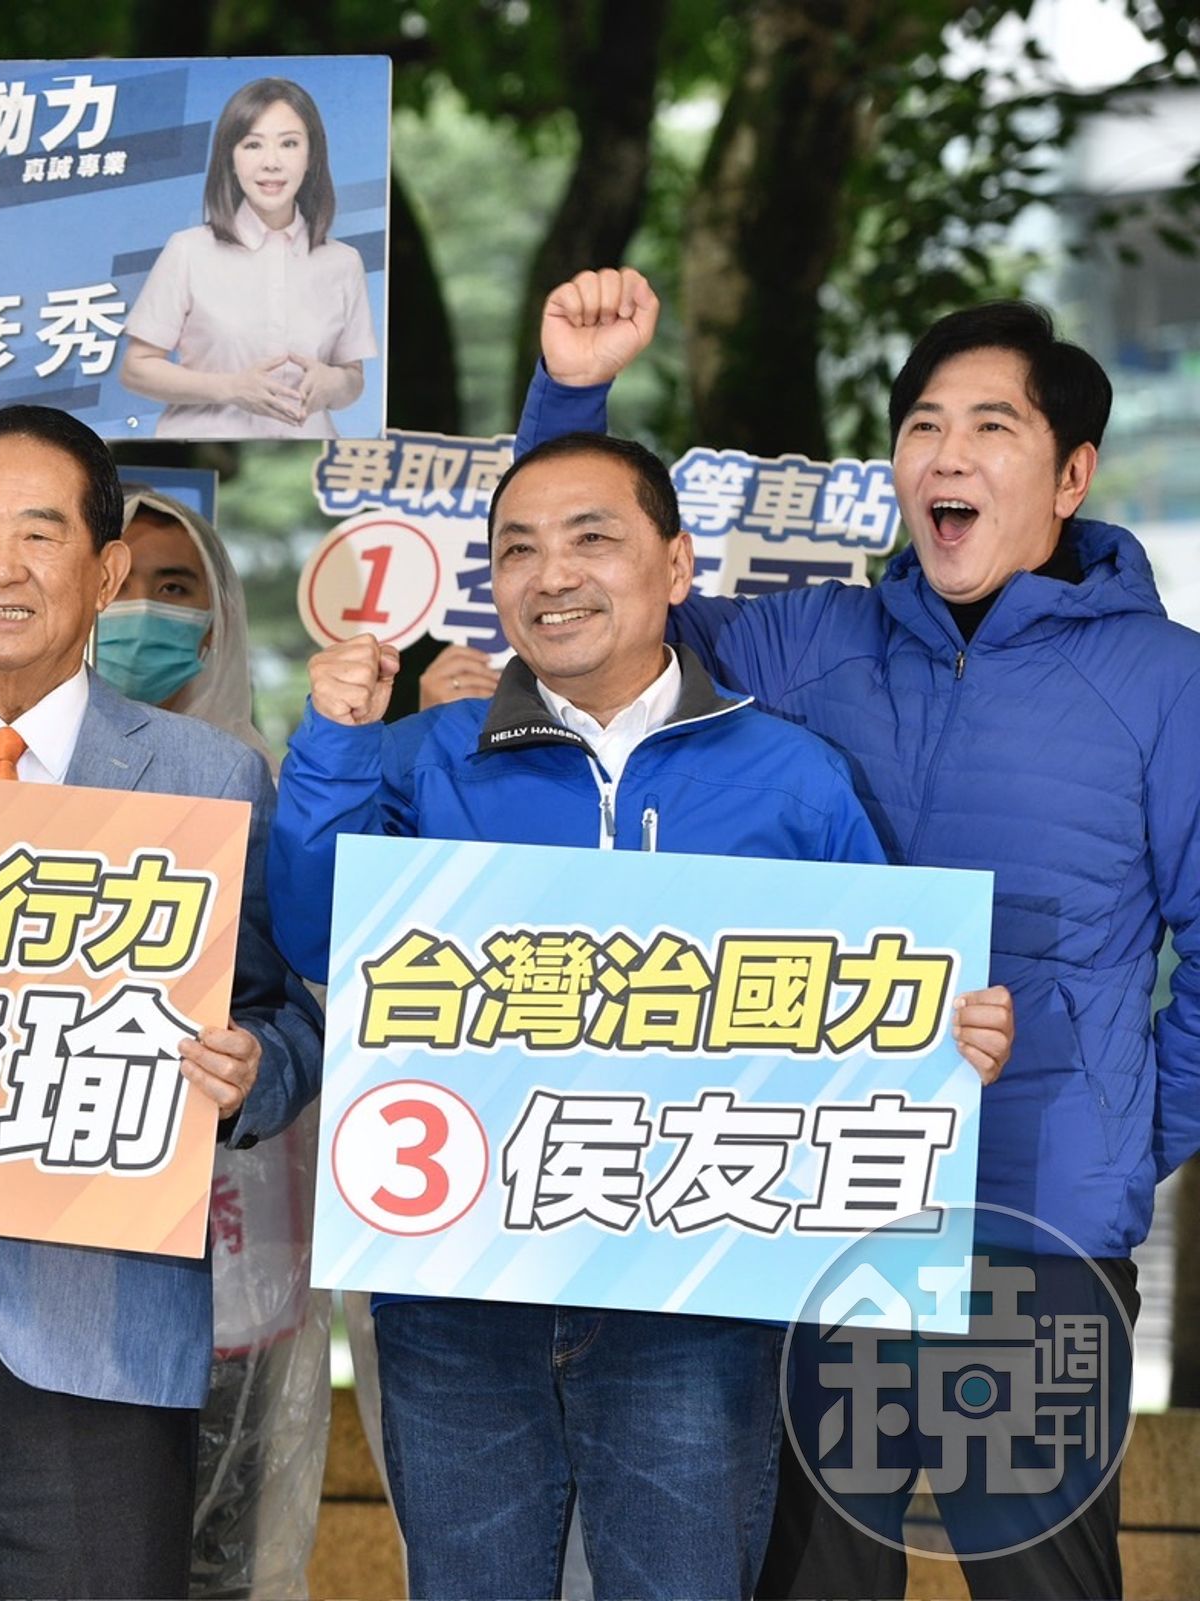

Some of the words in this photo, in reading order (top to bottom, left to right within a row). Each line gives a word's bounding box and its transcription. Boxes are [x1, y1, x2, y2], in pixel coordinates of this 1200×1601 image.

[341, 545, 393, 624] 1
[491, 727, 528, 743] HELLY
[358, 928, 953, 1054] 台灣治國力
[370, 1098, 450, 1217] 3
[503, 1090, 958, 1233] 侯友宜
